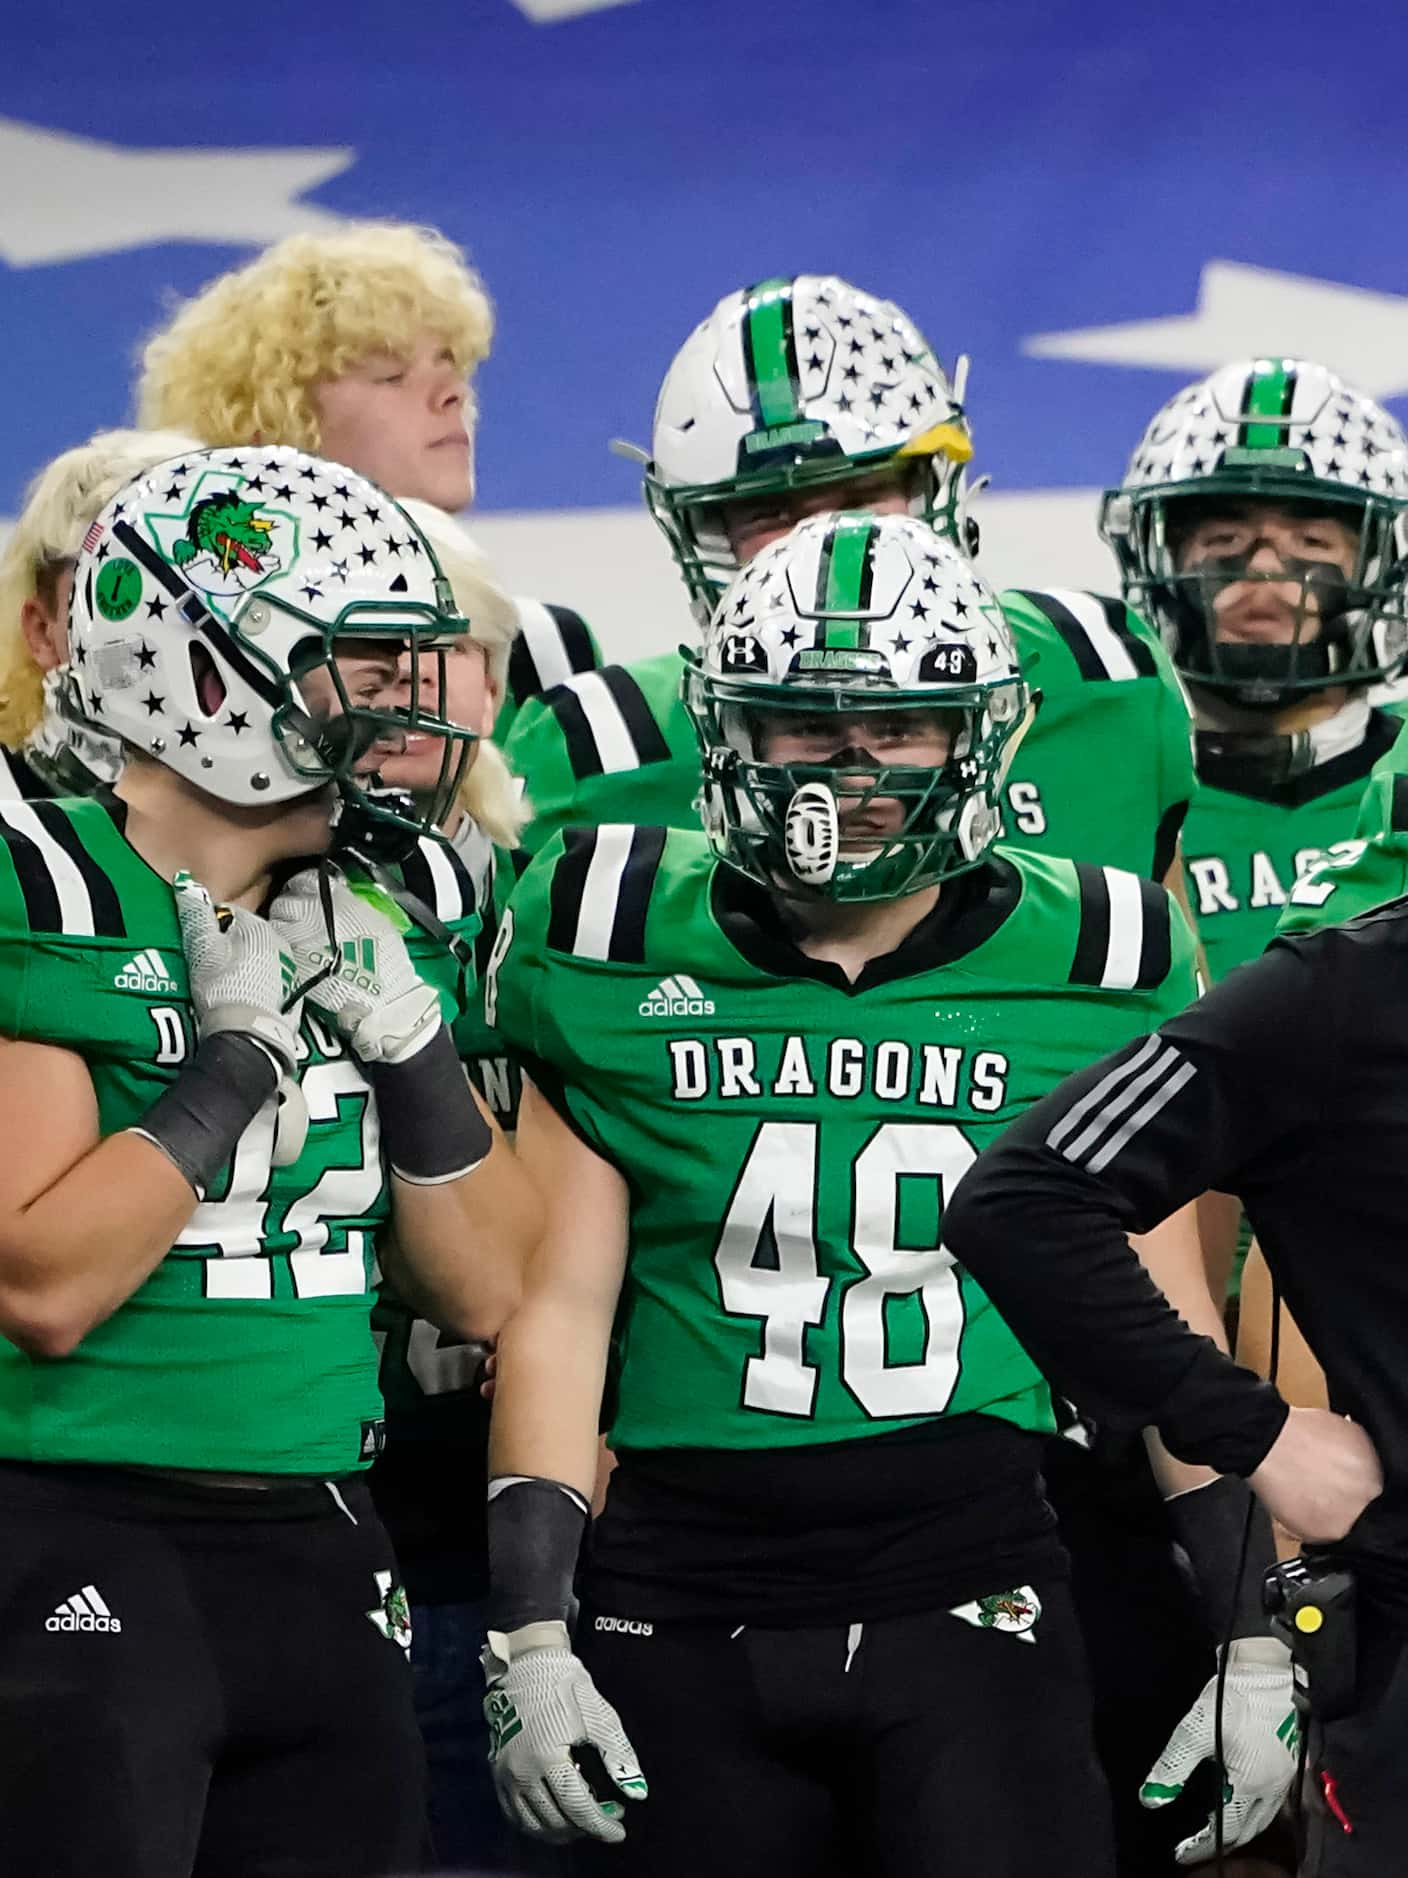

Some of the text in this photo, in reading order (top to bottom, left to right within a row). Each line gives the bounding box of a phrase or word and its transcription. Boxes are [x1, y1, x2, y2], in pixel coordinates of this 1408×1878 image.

[638, 997, 716, 1017] adidas
[668, 1036, 1008, 1113] DRAGONS
[713, 1121, 980, 1418] 48
[44, 1612, 121, 1633] adidas
